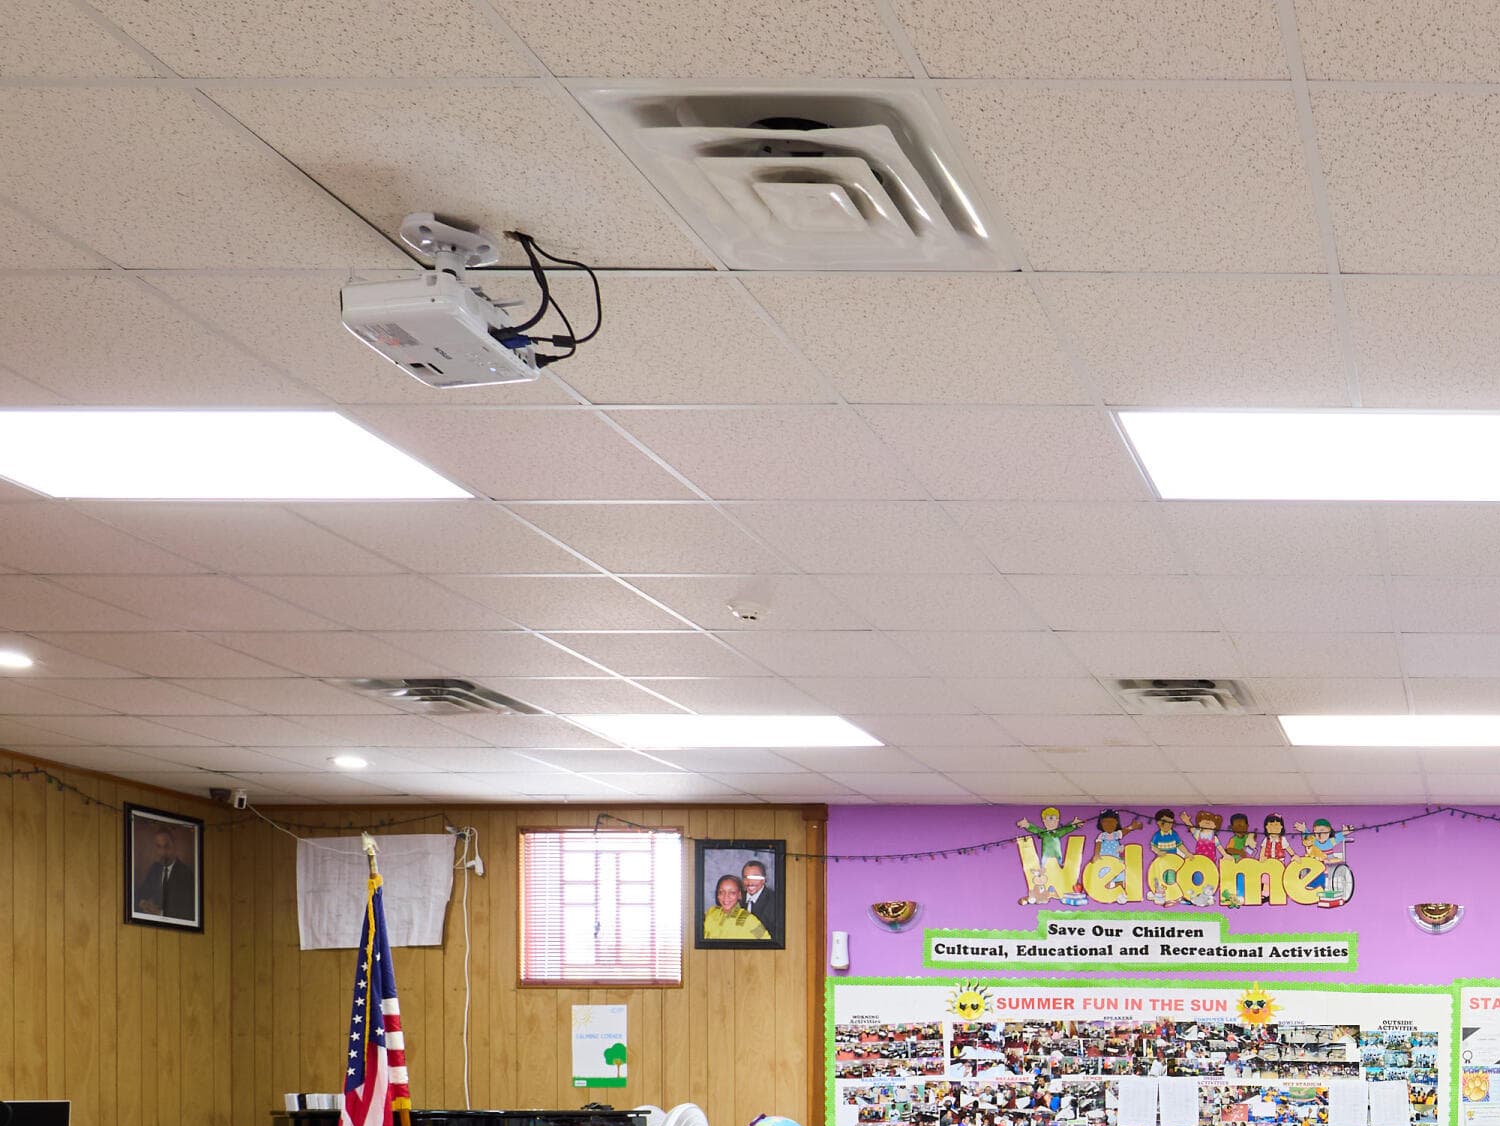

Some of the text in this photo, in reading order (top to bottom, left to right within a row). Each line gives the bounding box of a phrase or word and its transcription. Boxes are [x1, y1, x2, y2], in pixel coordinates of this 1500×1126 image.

[1017, 834, 1328, 907] Welcome
[1047, 924, 1204, 938] Save Our Children
[934, 943, 1348, 959] Cultural, Educational and Recreational Activities
[996, 998, 1228, 1012] SUMMER FUN IN THE SUN
